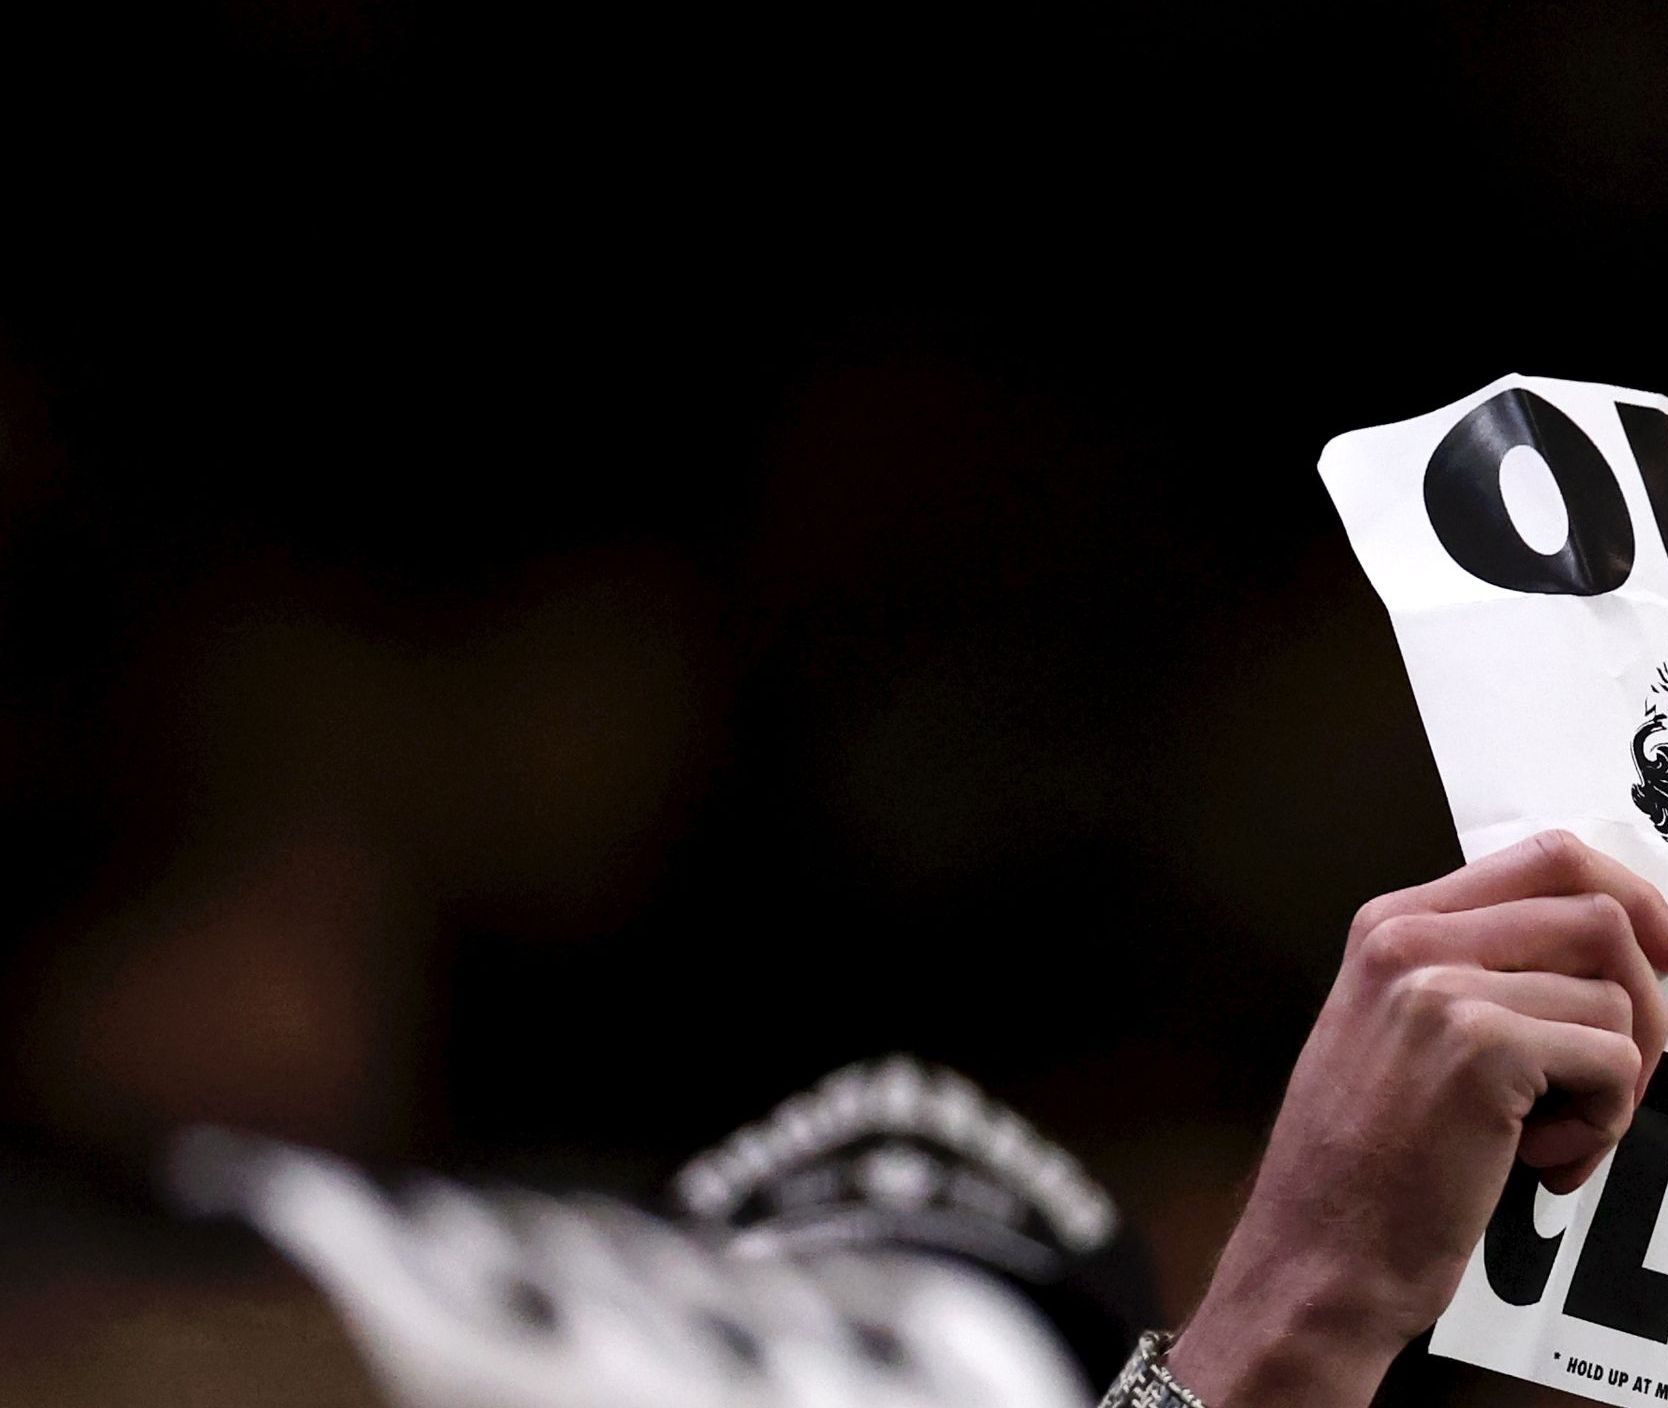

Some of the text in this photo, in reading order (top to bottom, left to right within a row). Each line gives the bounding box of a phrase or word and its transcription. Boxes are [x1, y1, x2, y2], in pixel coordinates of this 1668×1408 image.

[1566, 1356, 1604, 1381] HOLD
[1607, 1370, 1629, 1388] UP
[1632, 1376, 1653, 1394] AT
